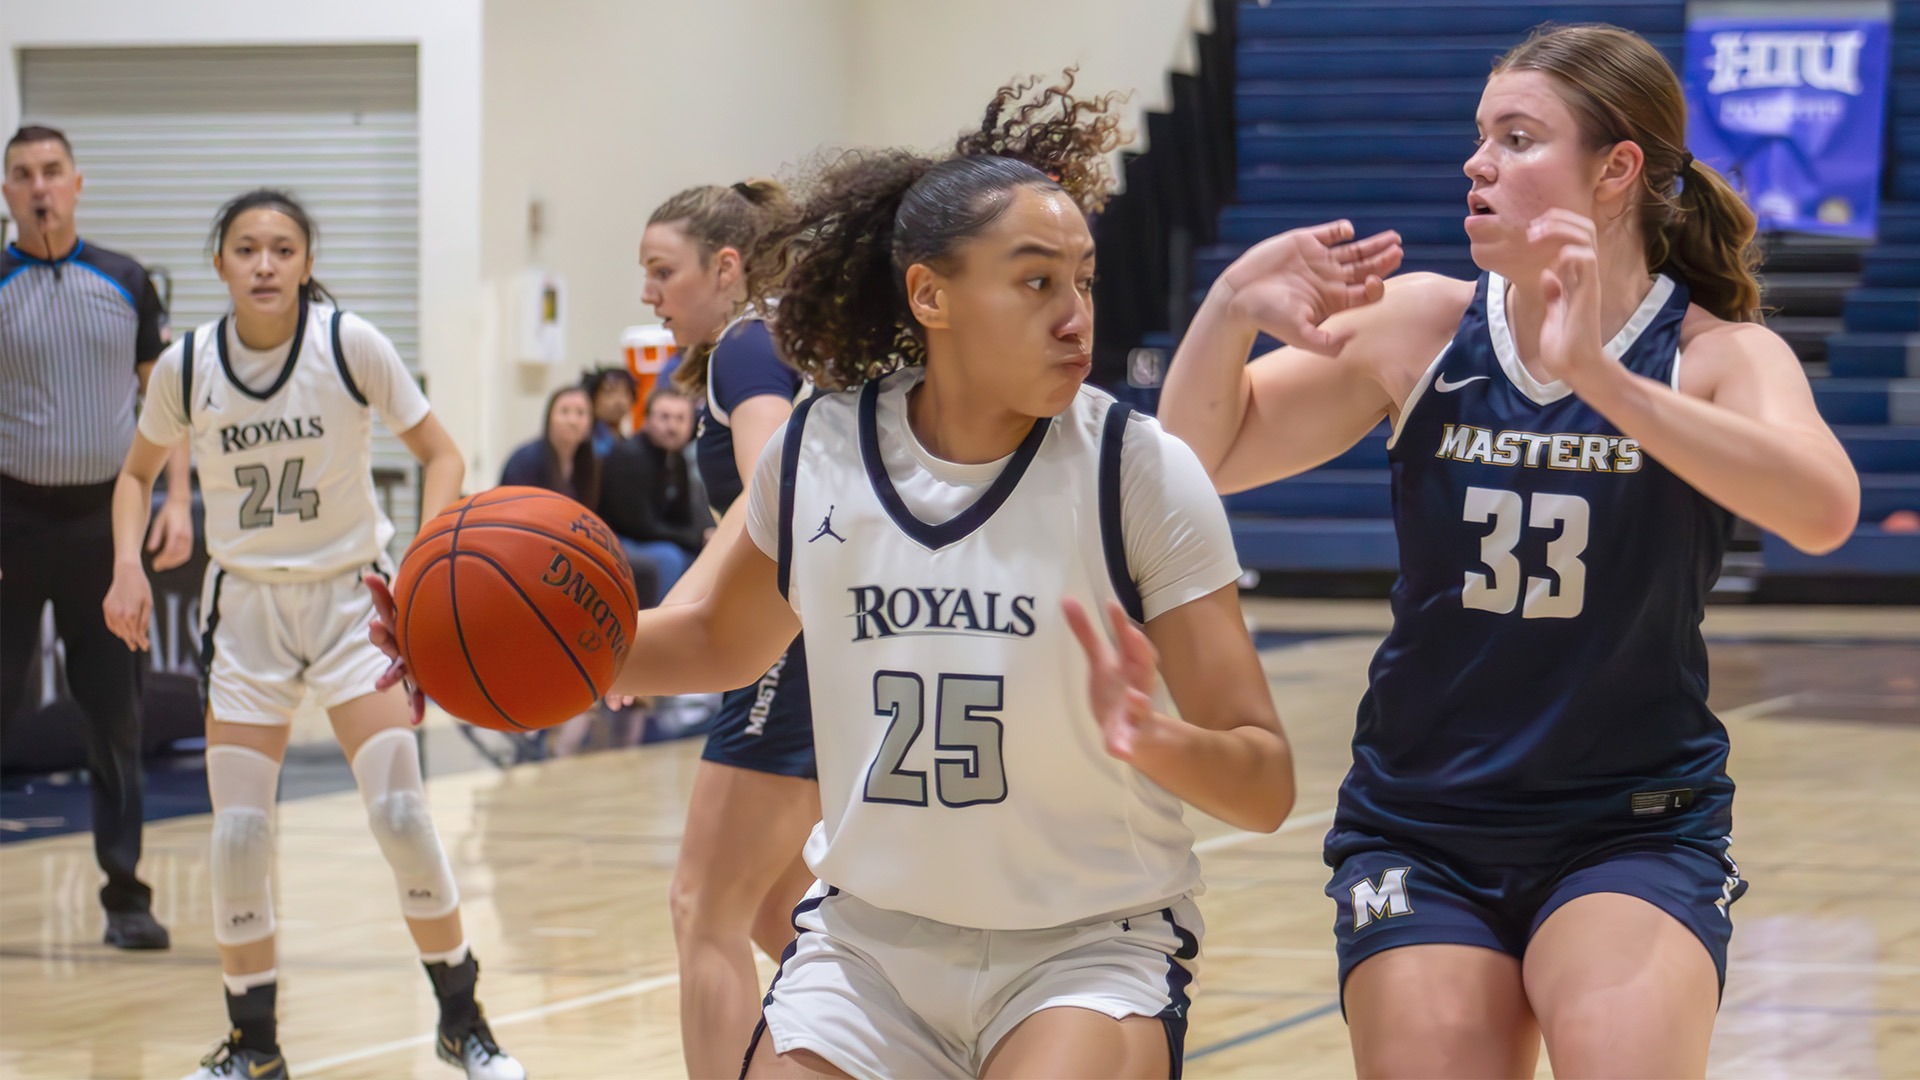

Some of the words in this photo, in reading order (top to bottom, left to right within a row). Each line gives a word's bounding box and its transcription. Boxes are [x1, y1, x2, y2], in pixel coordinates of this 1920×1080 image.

[219, 416, 325, 454] ROYALS
[1435, 423, 1643, 474] MASTER'S
[234, 457, 321, 530] 24
[1461, 486, 1590, 619] 33
[847, 585, 1036, 642] ROYALS
[862, 669, 1008, 808] 25
[1674, 796, 1682, 808] L
[1349, 866, 1414, 933] M
